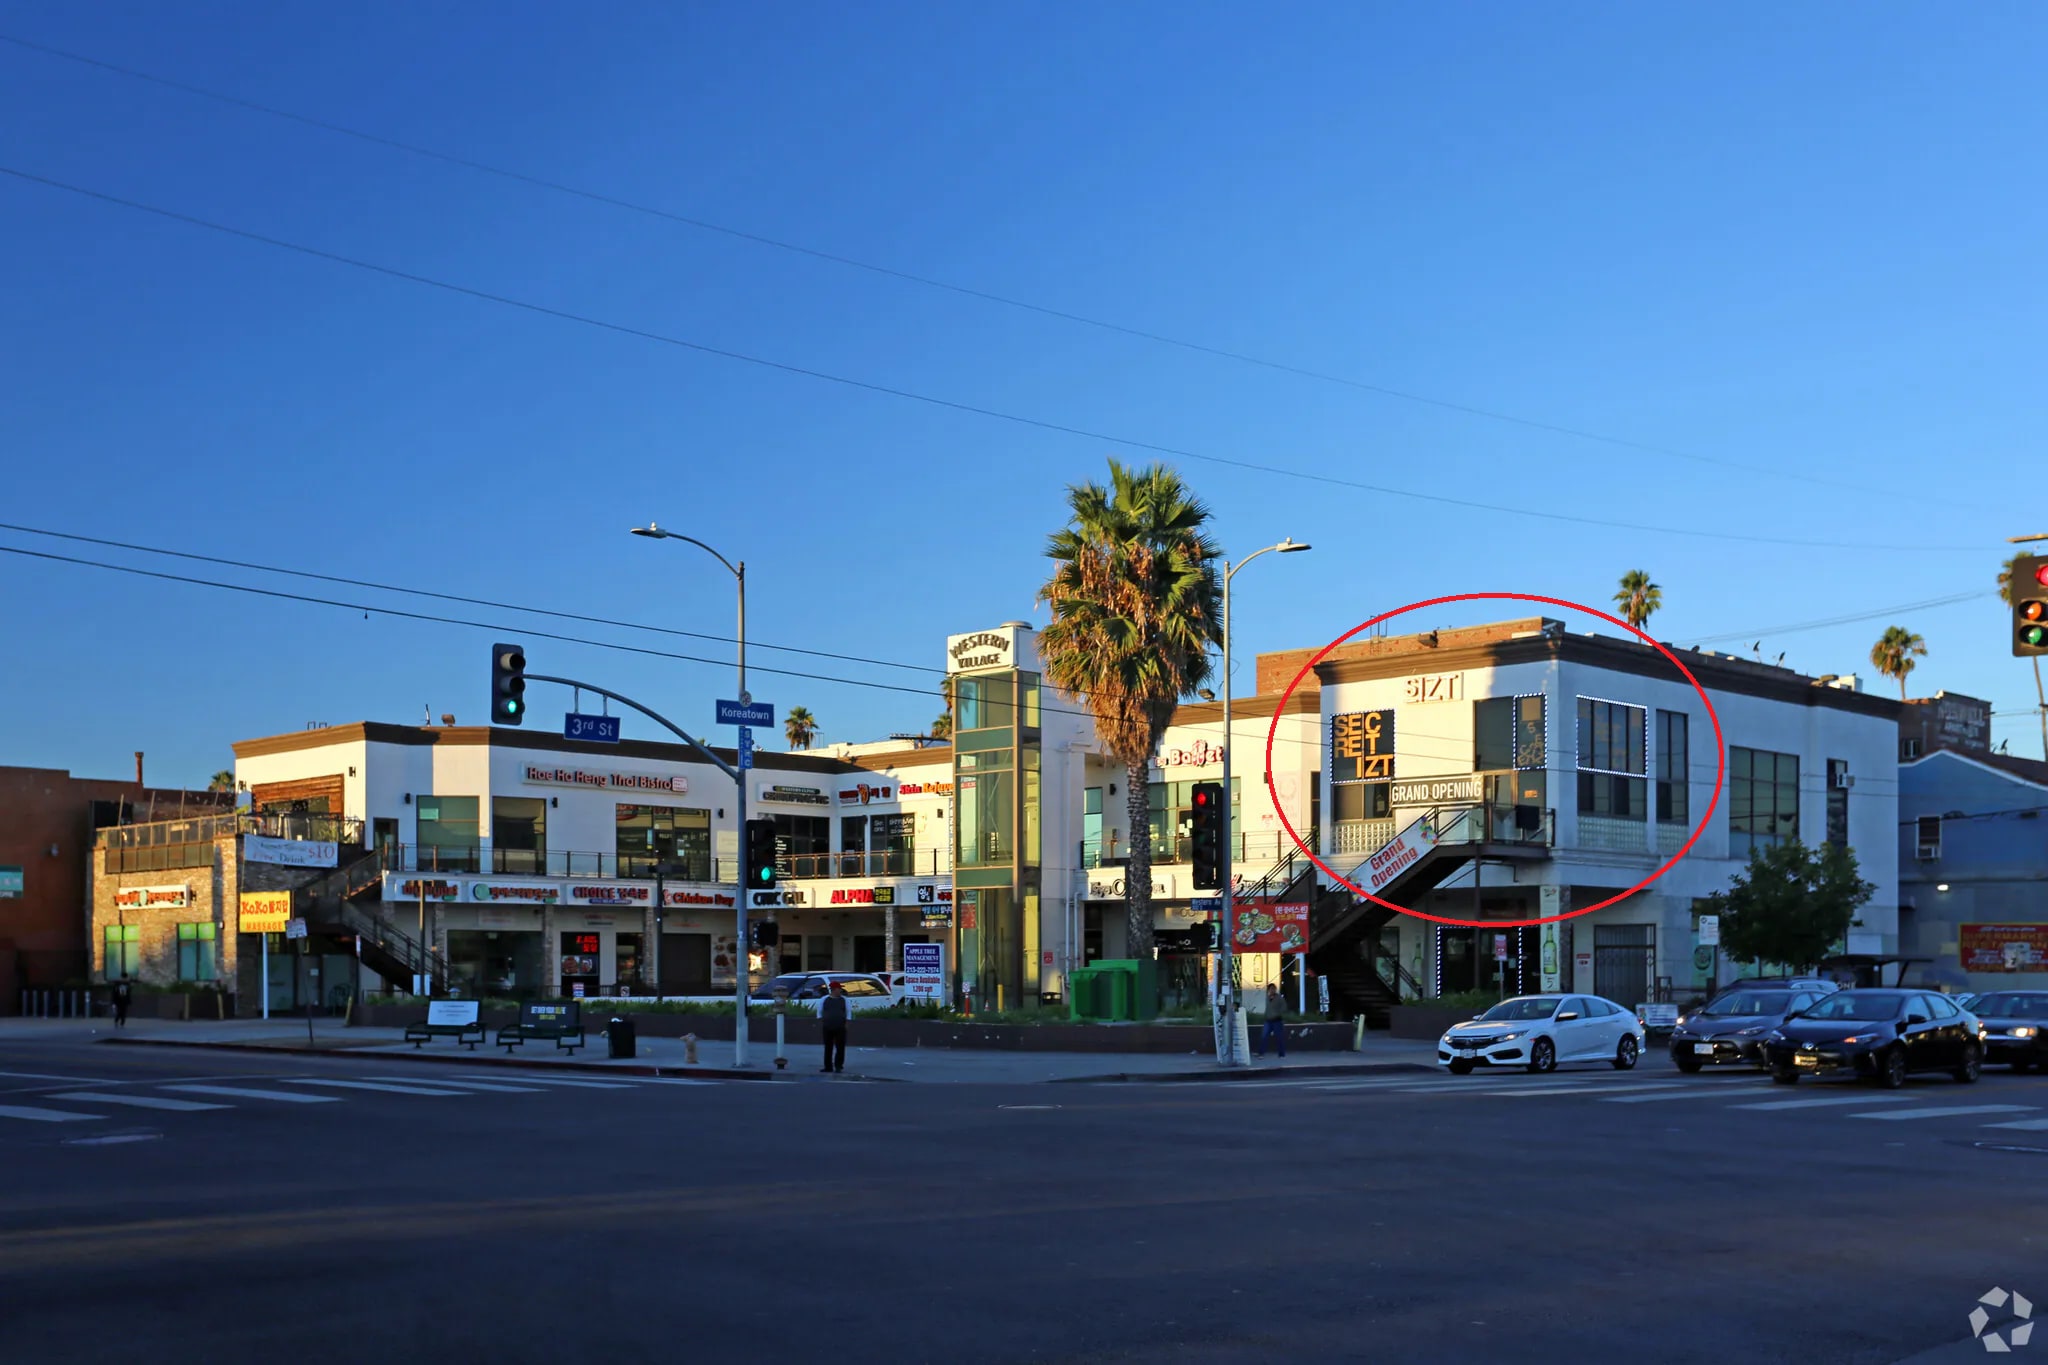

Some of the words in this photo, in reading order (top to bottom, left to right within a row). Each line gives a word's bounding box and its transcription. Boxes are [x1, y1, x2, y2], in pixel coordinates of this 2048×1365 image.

[949, 634, 1010, 658] WESTERN
[958, 653, 1001, 668] VILLAGE
[721, 706, 769, 720] Koreatown
[572, 719, 594, 735] 3rd
[598, 722, 613, 736] St
[611, 773, 637, 787] Thai
[638, 776, 672, 790] Bistro
[1392, 784, 1429, 802] GRAND
[1431, 780, 1481, 801] OPENING
[279, 853, 304, 864] Drink
[308, 845, 334, 859] $10
[1370, 838, 1405, 870] Grand
[1370, 847, 1418, 887] Opening
[573, 886, 615, 899] CHOICE
[714, 893, 735, 907] Day
[830, 889, 874, 904] ALPHA
[245, 921, 282, 931] MASSAGE
[906, 976, 918, 984] Space
[919, 975, 940, 984] Available
